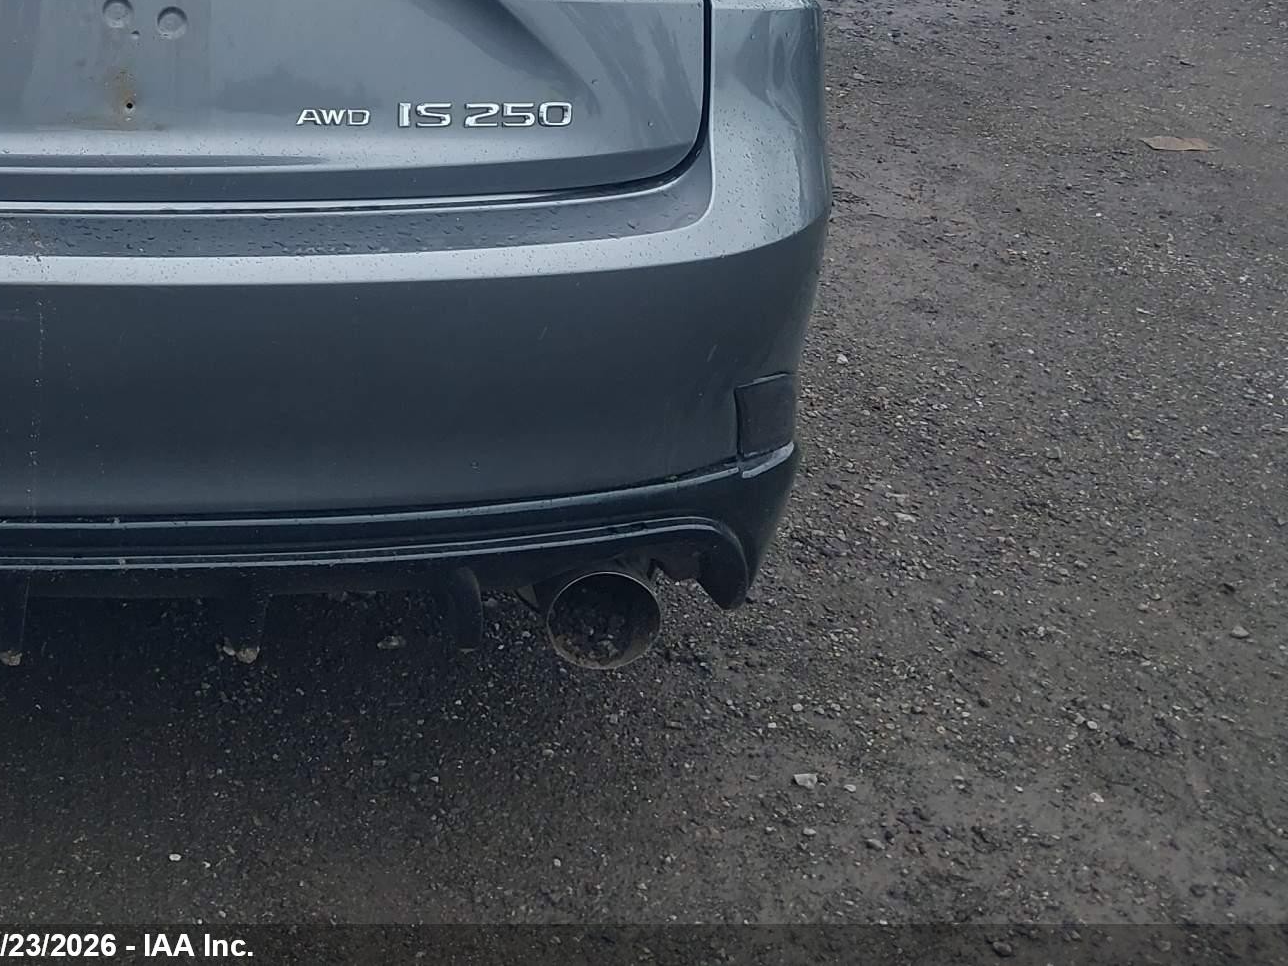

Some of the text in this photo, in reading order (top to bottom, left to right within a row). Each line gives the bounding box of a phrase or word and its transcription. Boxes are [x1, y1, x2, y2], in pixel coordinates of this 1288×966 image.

[295, 101, 573, 128] AWD IS 250
